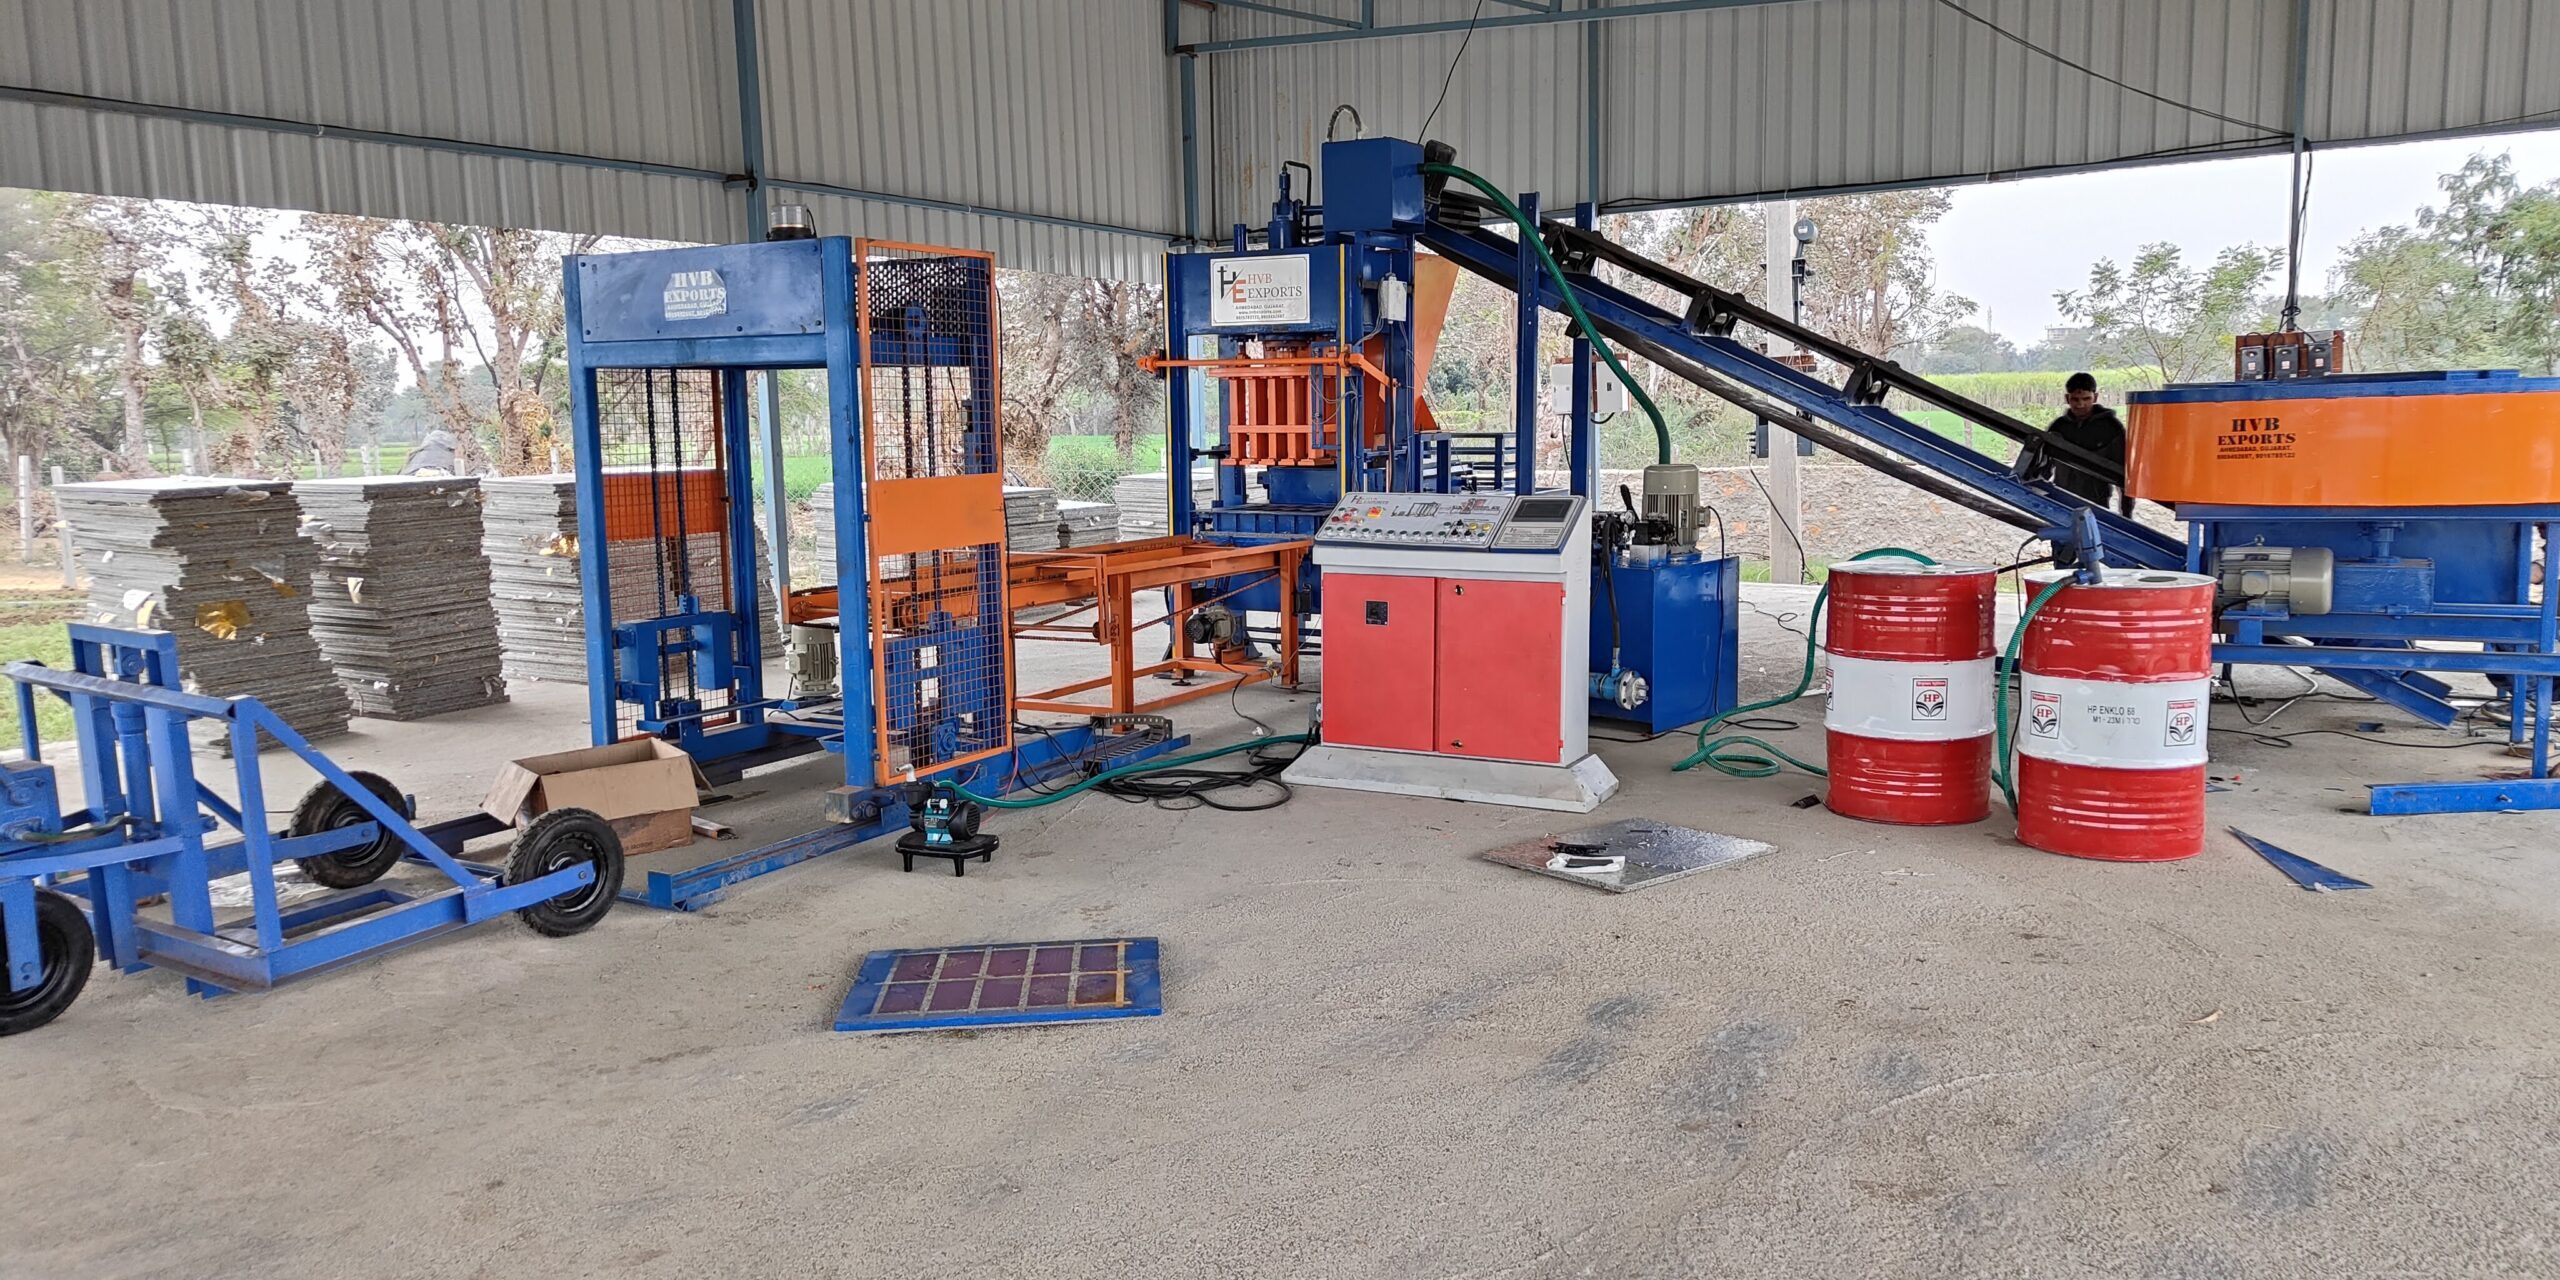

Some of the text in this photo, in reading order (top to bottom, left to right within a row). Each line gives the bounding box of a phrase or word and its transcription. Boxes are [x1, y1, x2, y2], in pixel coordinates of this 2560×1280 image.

[674, 270, 713, 288] HVB
[1248, 274, 1272, 284] HVB
[664, 287, 726, 303] EXPORTS
[1248, 286, 1302, 298] EXPORTS
[2232, 418, 2280, 432] HVB
[2218, 433, 2296, 446] EXPORTS
[1924, 694, 1940, 702] HP
[2036, 708, 2052, 718] HP
[2087, 705, 2098, 714] HP
[2099, 706, 2125, 716] ENKLO
[2176, 716, 2190, 726] HP
